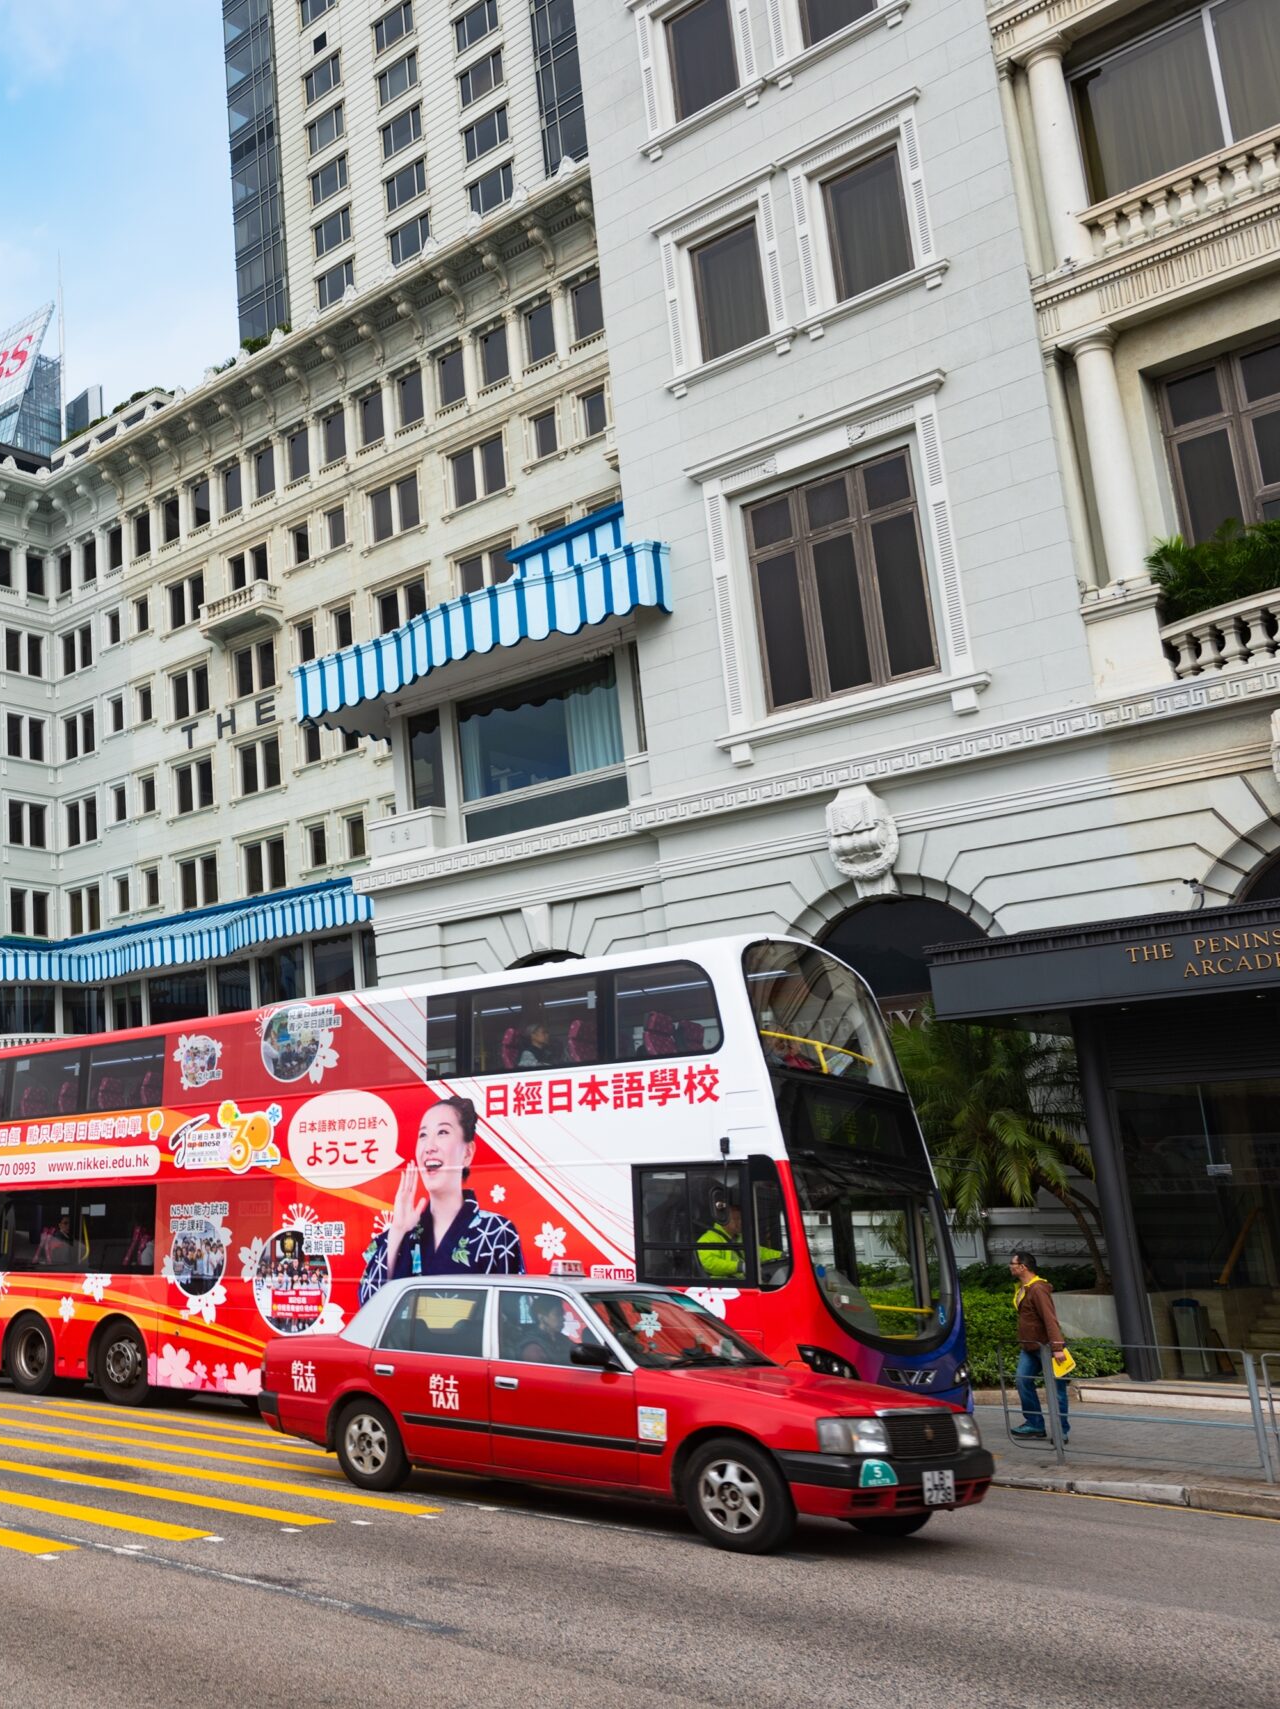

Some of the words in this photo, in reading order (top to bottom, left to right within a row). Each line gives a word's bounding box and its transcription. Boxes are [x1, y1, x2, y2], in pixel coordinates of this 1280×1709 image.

[181, 695, 276, 749] THE
[1125, 943, 1174, 963] THE
[486, 1064, 720, 1118] 日經日本語學校
[299, 1117, 388, 1133] 日本語教育の日経へ
[307, 1139, 379, 1167] ようこそ
[12, 1162, 36, 1175] 0993
[48, 1154, 150, 1173] www.nikkei.edu.hk
[305, 1224, 344, 1236] 日本留學
[305, 1240, 344, 1253] 暑期留日
[605, 1268, 635, 1282] KMB
[291, 1360, 316, 1377] 的士
[292, 1376, 316, 1393] TAXI
[429, 1374, 459, 1392] 的士
[429, 1391, 459, 1410] TAXI
[873, 1467, 882, 1478] 5
